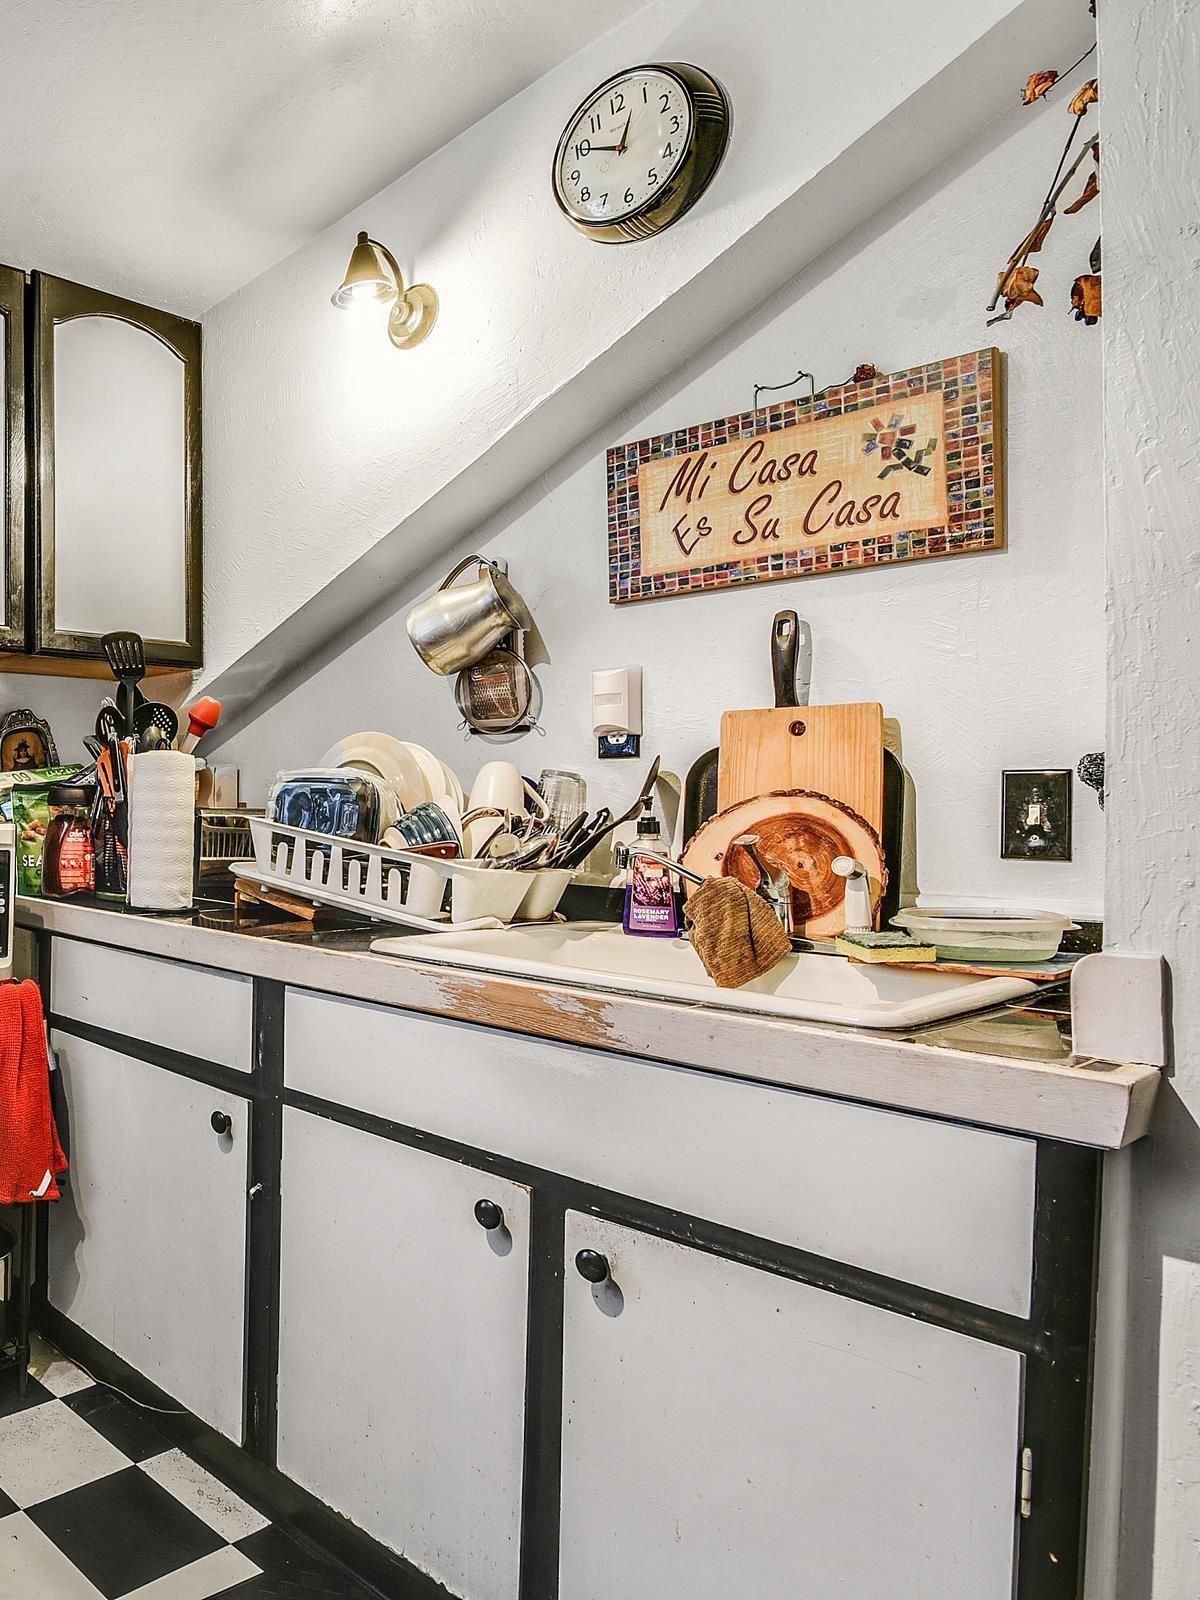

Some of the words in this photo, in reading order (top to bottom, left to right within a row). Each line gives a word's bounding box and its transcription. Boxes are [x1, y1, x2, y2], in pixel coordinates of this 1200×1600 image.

[610, 93, 625, 115] 12
[642, 87, 647, 103] 1
[659, 94, 671, 114] 2
[590, 114, 601, 133] 11
[670, 116, 680, 134] 3
[575, 139, 591, 160] 10
[662, 142, 673, 159] 4
[571, 170, 580, 186] 9
[647, 168, 657, 186] 5
[580, 186, 591, 202] 8
[600, 193, 608, 206] 7
[624, 187, 634, 203] 6
[659, 451, 717, 511] Mi
[728, 440, 818, 494] Casa
[673, 514, 712, 556] Es
[733, 494, 780, 545] Su
[803, 480, 901, 536] Casa
